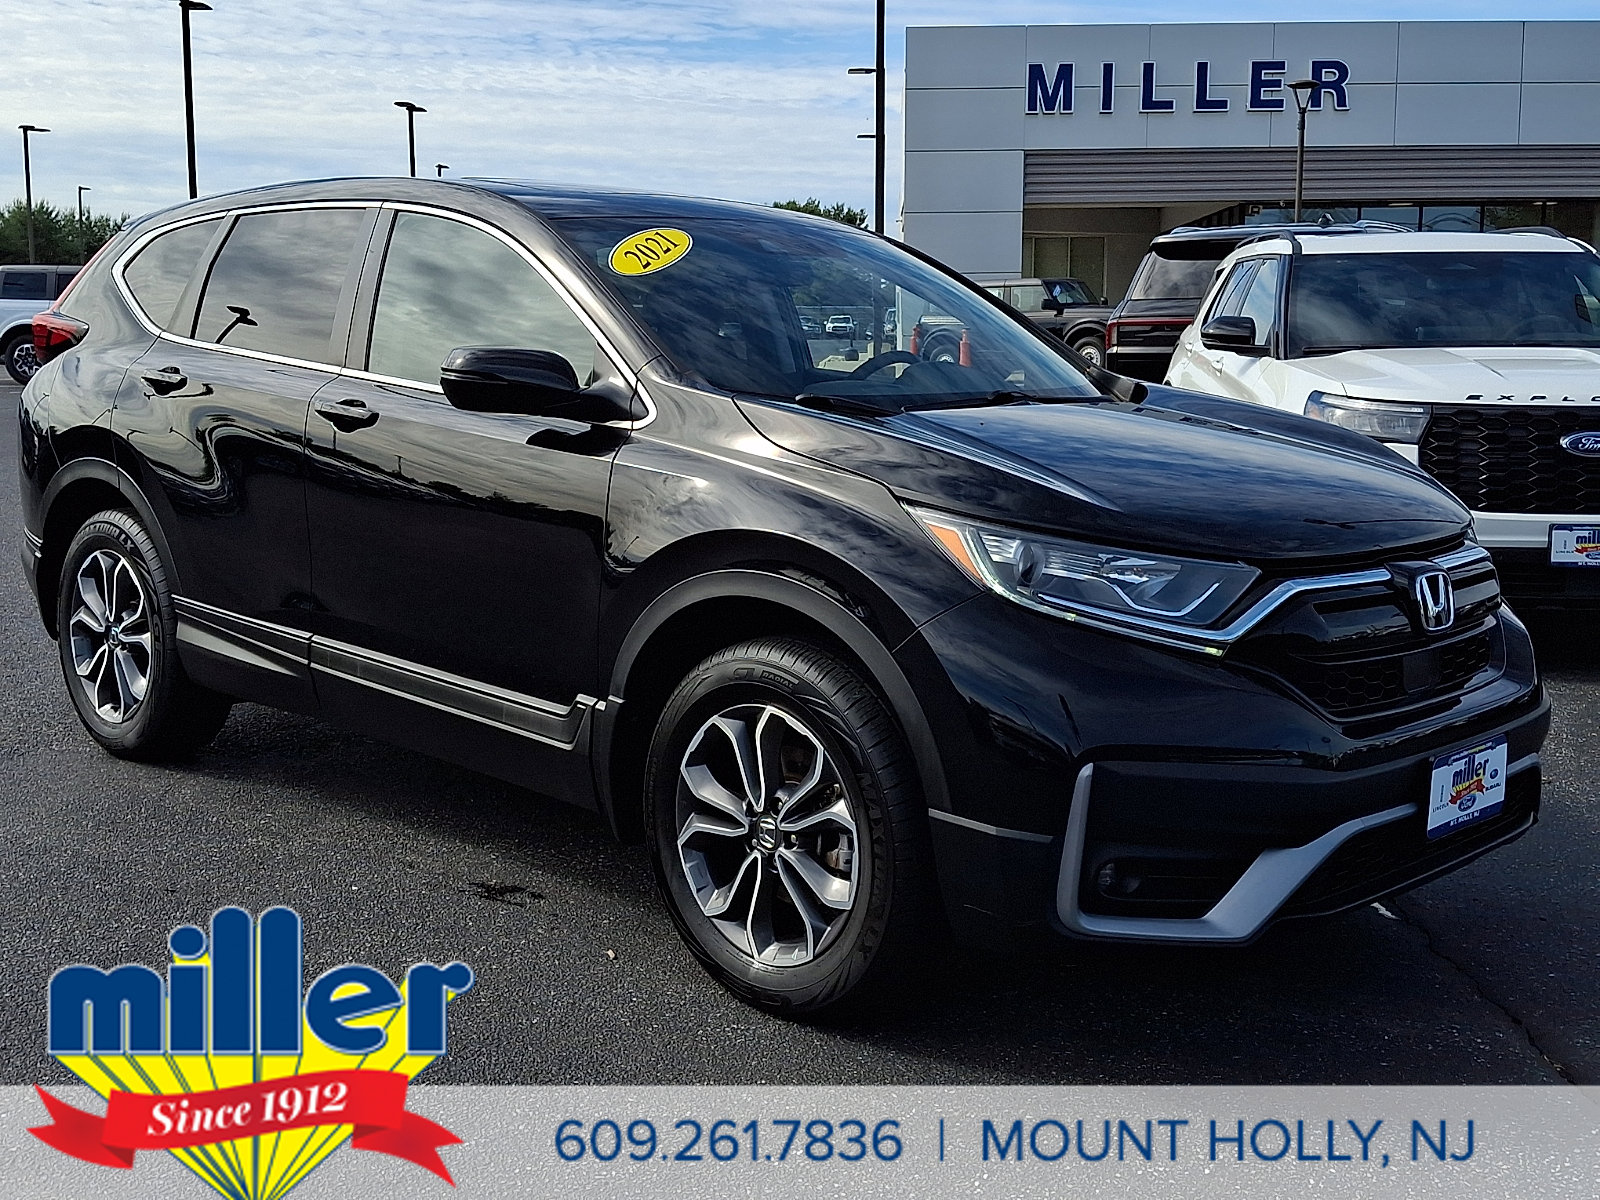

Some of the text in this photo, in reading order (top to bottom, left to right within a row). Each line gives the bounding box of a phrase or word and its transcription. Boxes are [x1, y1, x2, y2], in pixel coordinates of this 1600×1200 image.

[1025, 59, 1351, 114] MILLER
[623, 231, 681, 270] 2021
[1452, 754, 1490, 788] miller
